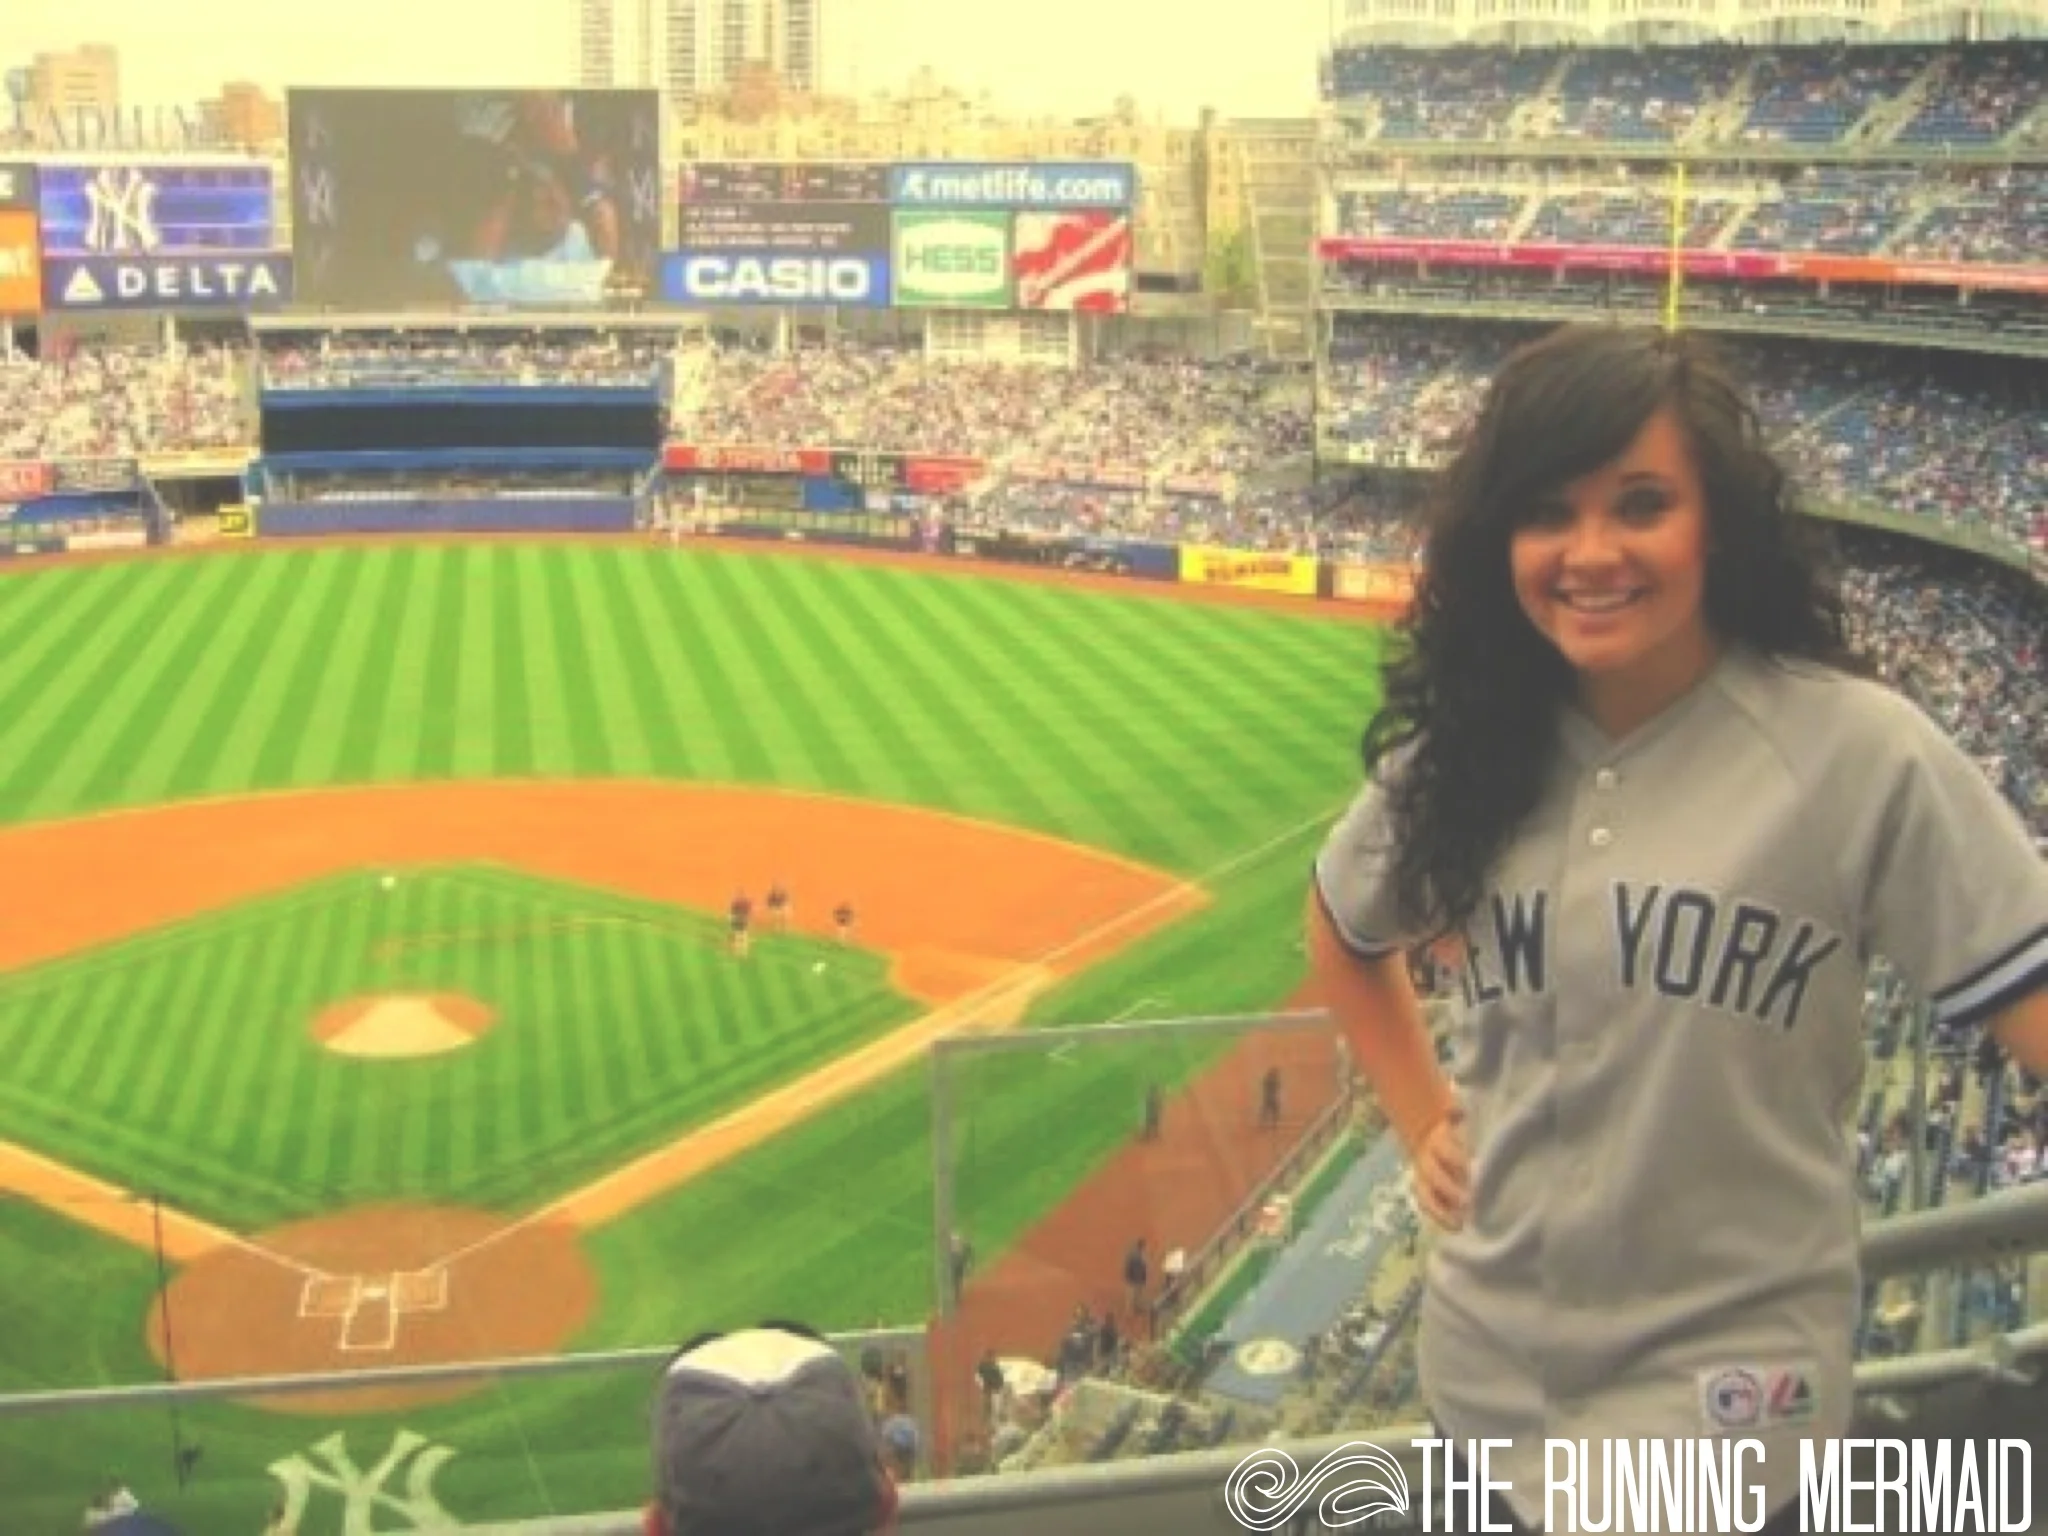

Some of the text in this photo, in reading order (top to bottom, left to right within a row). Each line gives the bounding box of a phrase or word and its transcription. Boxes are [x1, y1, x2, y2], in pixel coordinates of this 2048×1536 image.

[928, 166, 1123, 203] metlife.com
[685, 256, 871, 299] CASIO
[905, 244, 998, 274] HESS
[117, 263, 278, 298] DELTA
[1613, 878, 1844, 1032] YORK
